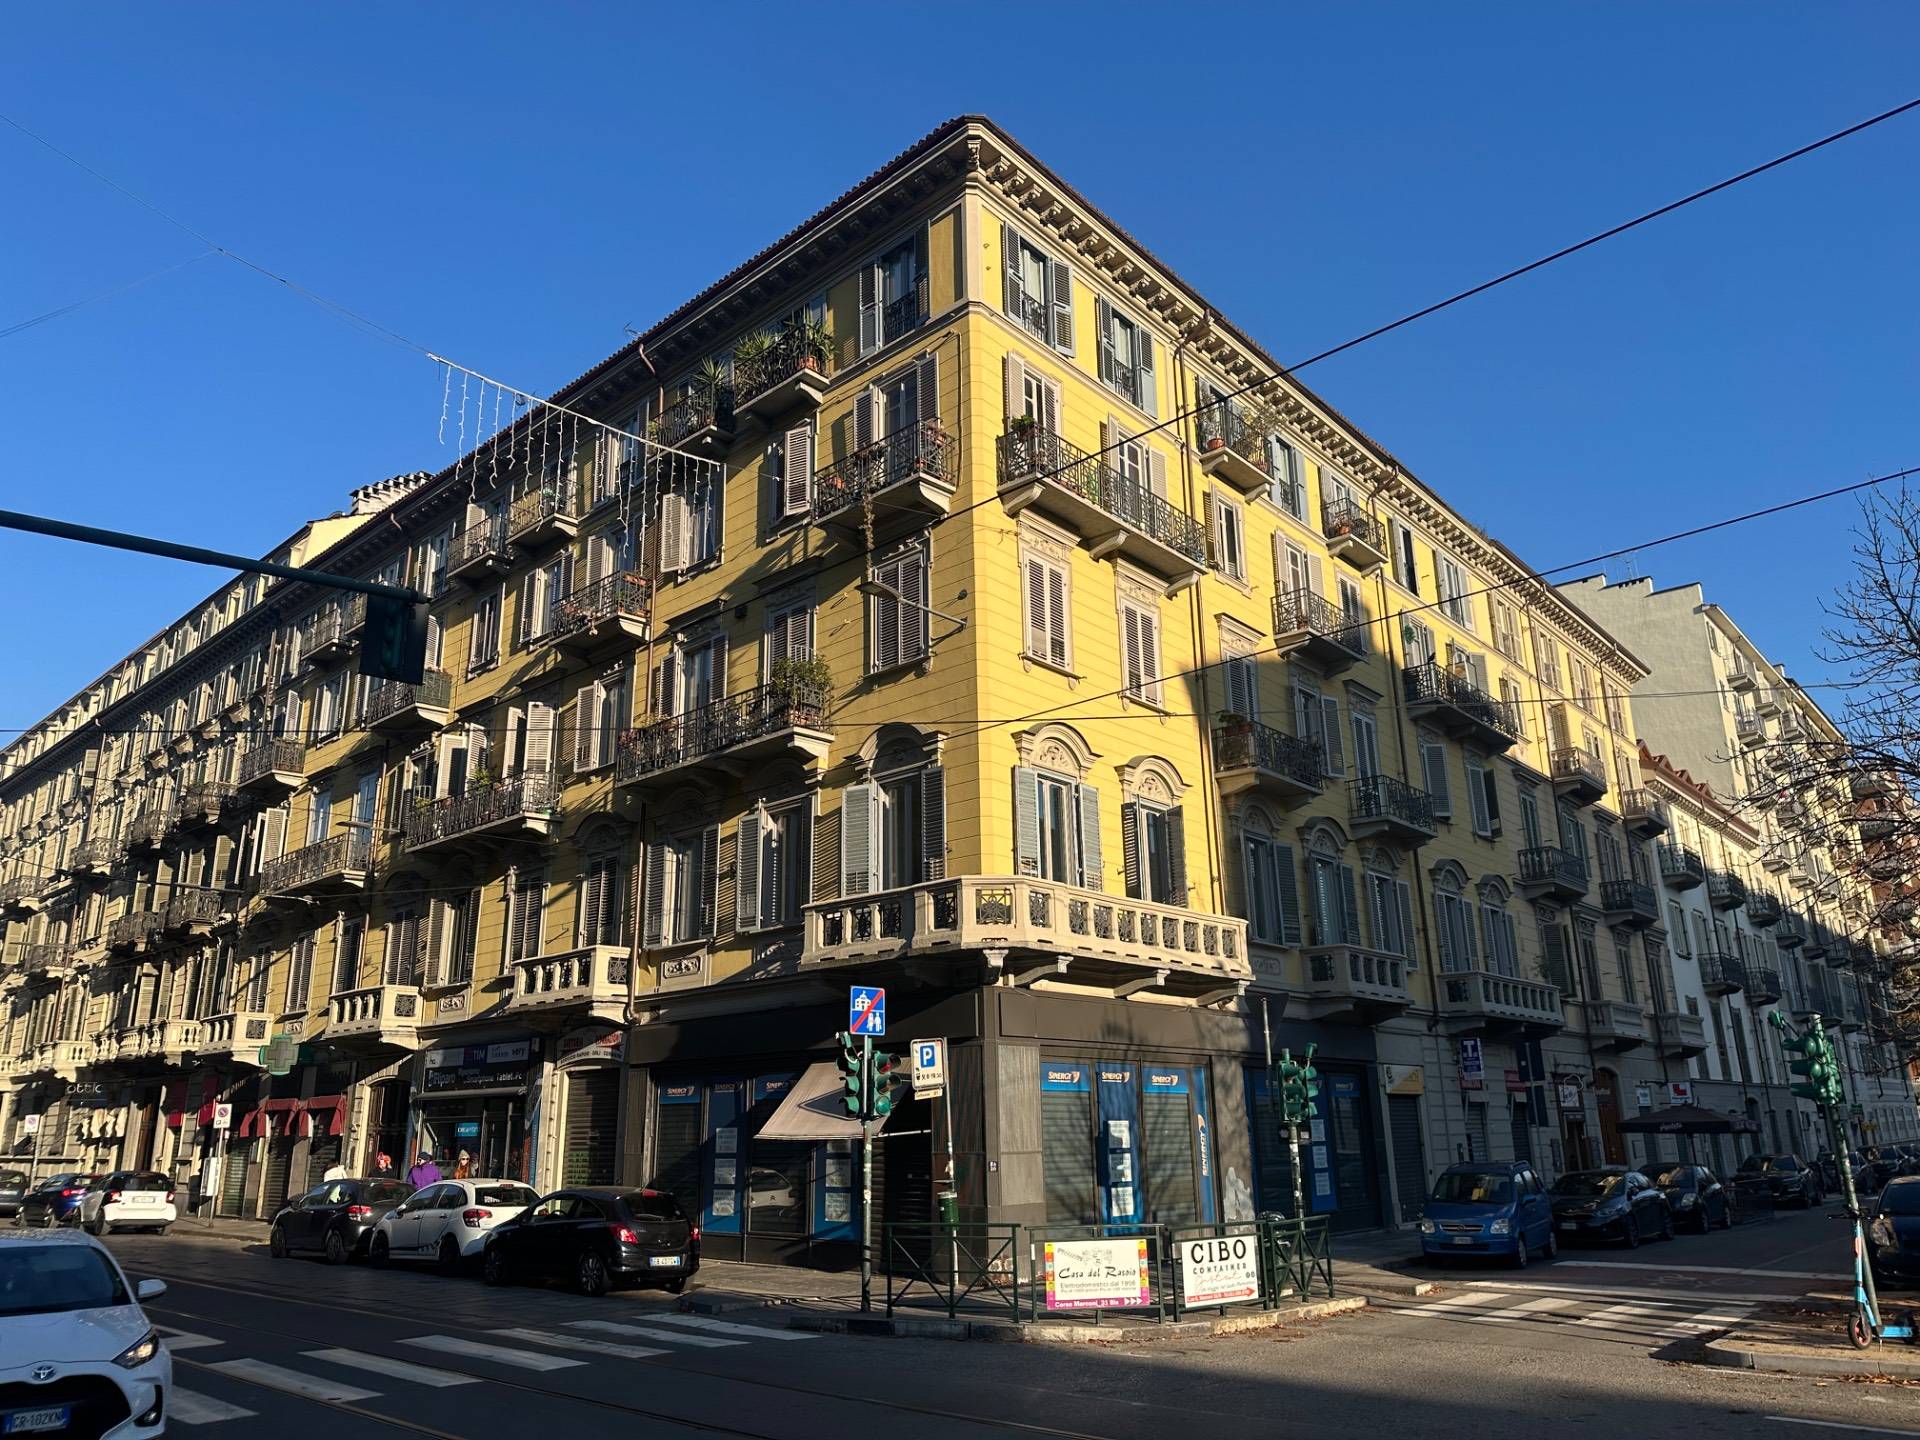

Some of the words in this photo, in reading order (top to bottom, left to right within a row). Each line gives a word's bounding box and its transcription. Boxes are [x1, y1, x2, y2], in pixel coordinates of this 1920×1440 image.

[922, 1047, 933, 1066] P
[1191, 1239, 1246, 1264] CIBO
[1058, 1267, 1084, 1279] Casa
[1088, 1267, 1101, 1278] del
[1104, 1266, 1136, 1278] Rasoio
[1193, 1262, 1246, 1275] CONTAINER
